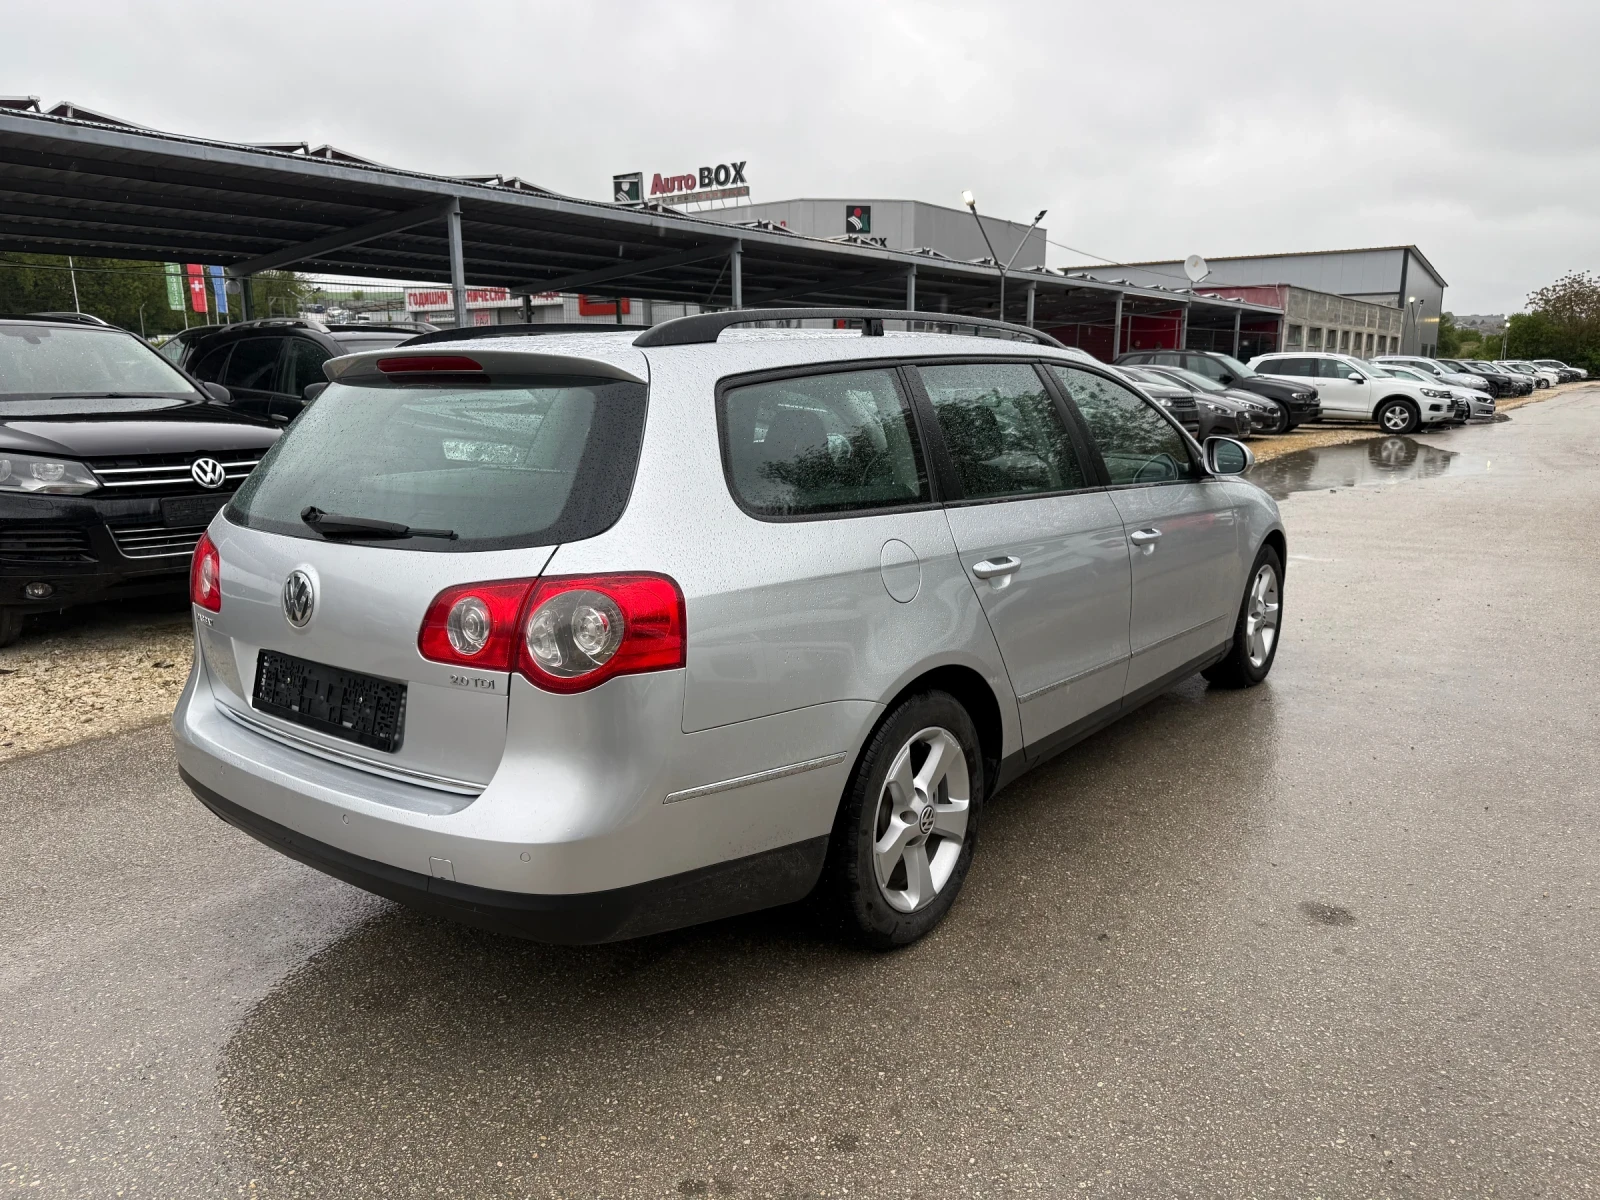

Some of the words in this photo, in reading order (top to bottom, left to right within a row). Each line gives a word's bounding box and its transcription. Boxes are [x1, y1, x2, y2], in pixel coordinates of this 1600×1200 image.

[699, 161, 747, 188] BOX
[408, 291, 448, 307] ГОДИШНИ
[450, 287, 507, 304] НИЧЕСКИ
[471, 677, 495, 689] TDI
